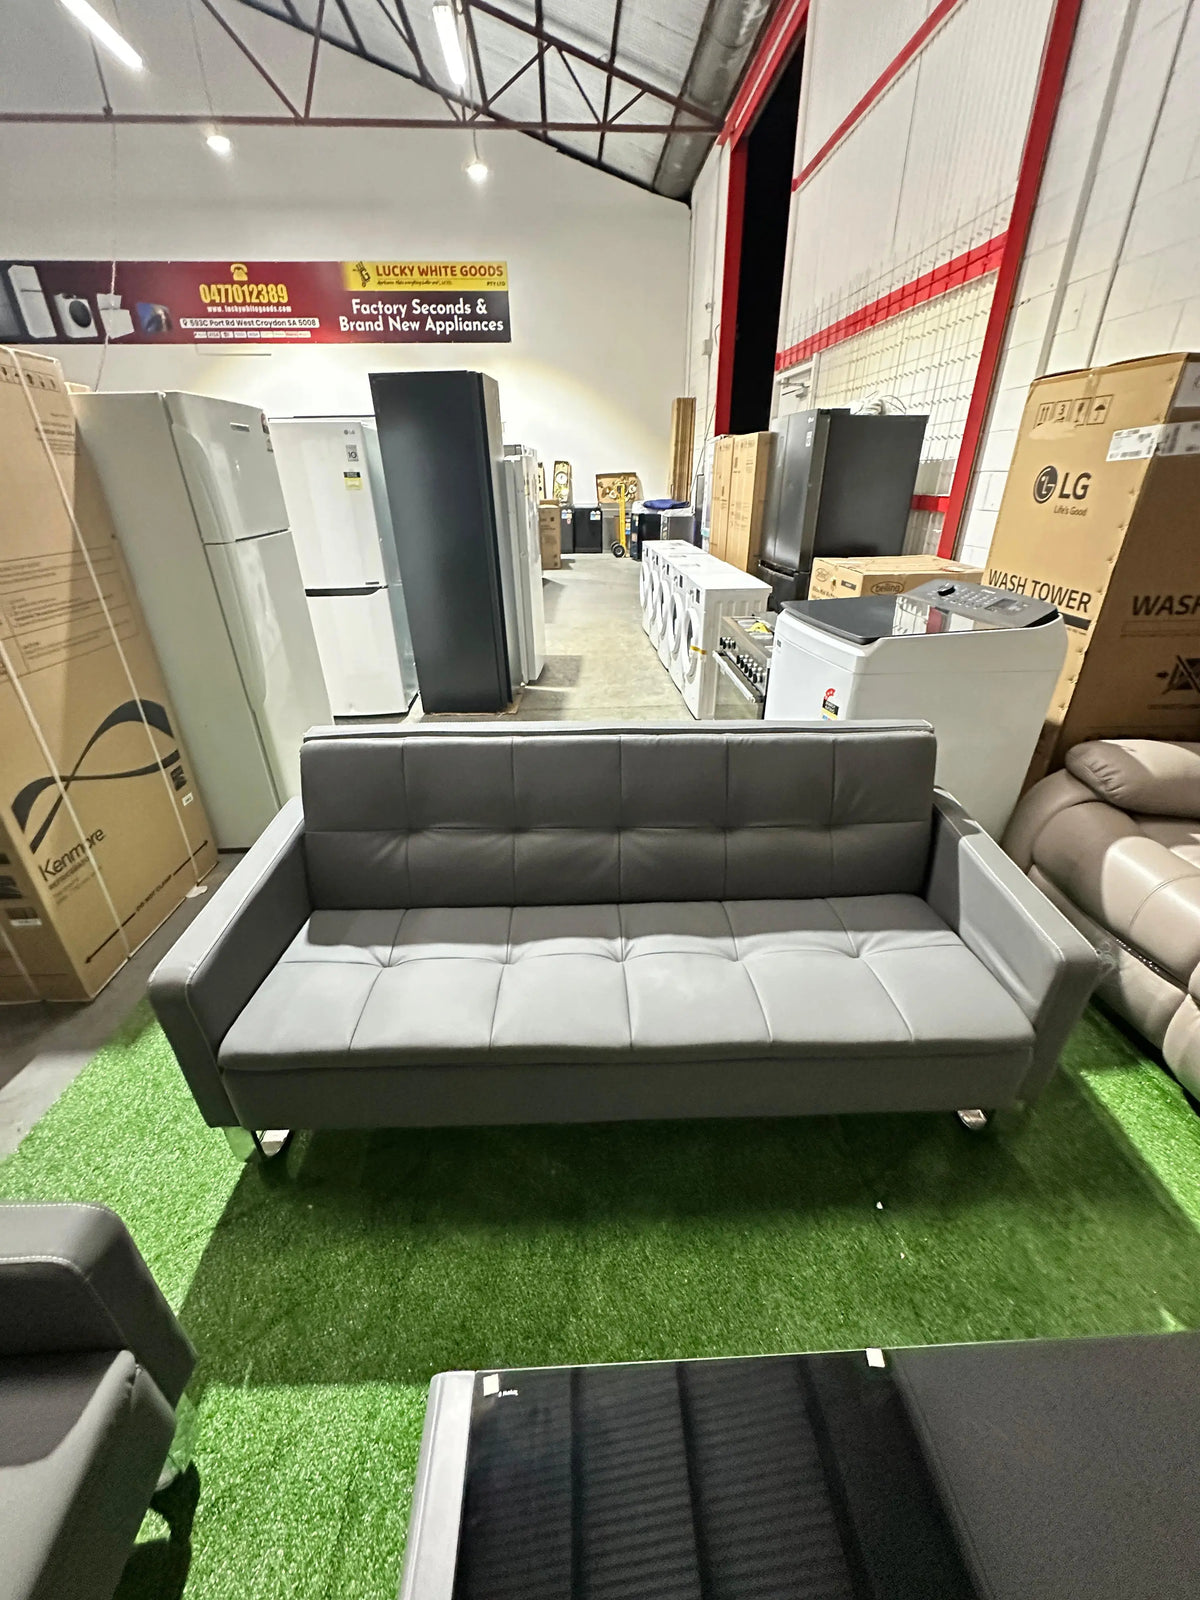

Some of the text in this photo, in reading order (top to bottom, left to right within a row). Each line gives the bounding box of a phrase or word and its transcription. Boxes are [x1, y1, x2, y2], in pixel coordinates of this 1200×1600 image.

[375, 265, 504, 277] LUCKY WHITE GOODS
[199, 283, 289, 304] 0477012389
[351, 297, 488, 318] Factory Seconds &
[209, 319, 225, 328] Port
[225, 319, 235, 328] Rd
[236, 319, 254, 328] West
[255, 319, 287, 329] Croydon
[287, 319, 298, 327] SA
[298, 318, 317, 327] 5008
[339, 315, 504, 335] Brand New Appliances
[1058, 472, 1092, 500] LG
[1069, 506, 1088, 517] Good
[988, 568, 1092, 613] WASH TOWER
